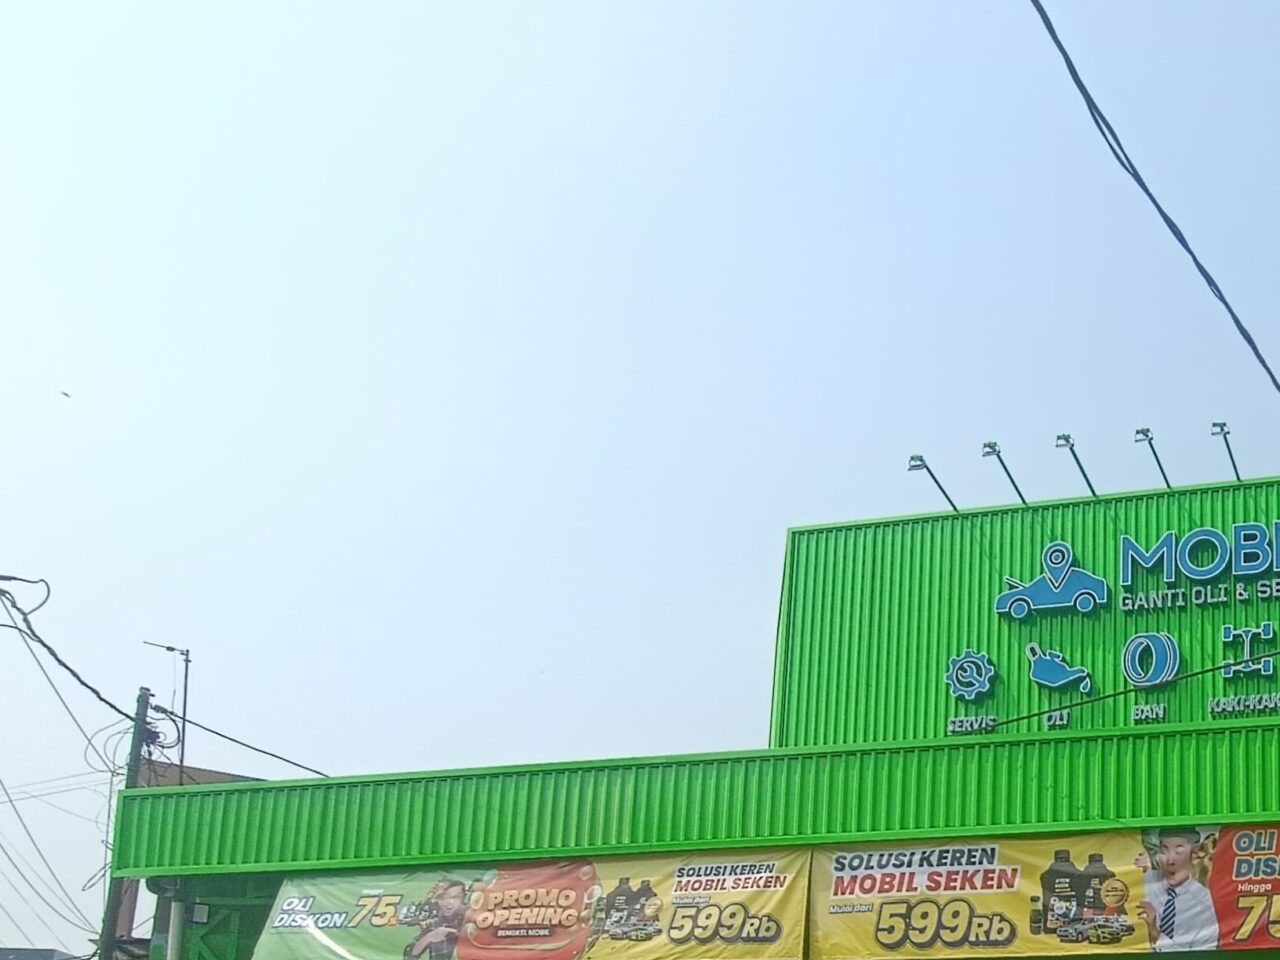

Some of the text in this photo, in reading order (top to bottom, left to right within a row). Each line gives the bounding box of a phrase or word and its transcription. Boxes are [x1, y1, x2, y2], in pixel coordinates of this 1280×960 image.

[1120, 588, 1186, 611] GANTI
[1191, 584, 1228, 604] OLI
[1236, 583, 1249, 600] &
[1045, 708, 1071, 727] OLI
[1132, 703, 1166, 721] BAN
[947, 715, 998, 735] SERVIS
[1233, 829, 1278, 855] OLI
[834, 847, 997, 872] SOLUSI KEREN
[676, 863, 776, 878] SOLUSI KEREN
[673, 875, 788, 893] MOBIL SEKEN
[833, 868, 1018, 896] MOBIL SEKEN
[1238, 883, 1272, 892] Hingga
[281, 896, 316, 912] OLI
[488, 888, 577, 910] PROMO
[829, 903, 873, 913] Mulai dari
[272, 912, 348, 928] DISKON
[476, 907, 579, 929] OPENING
